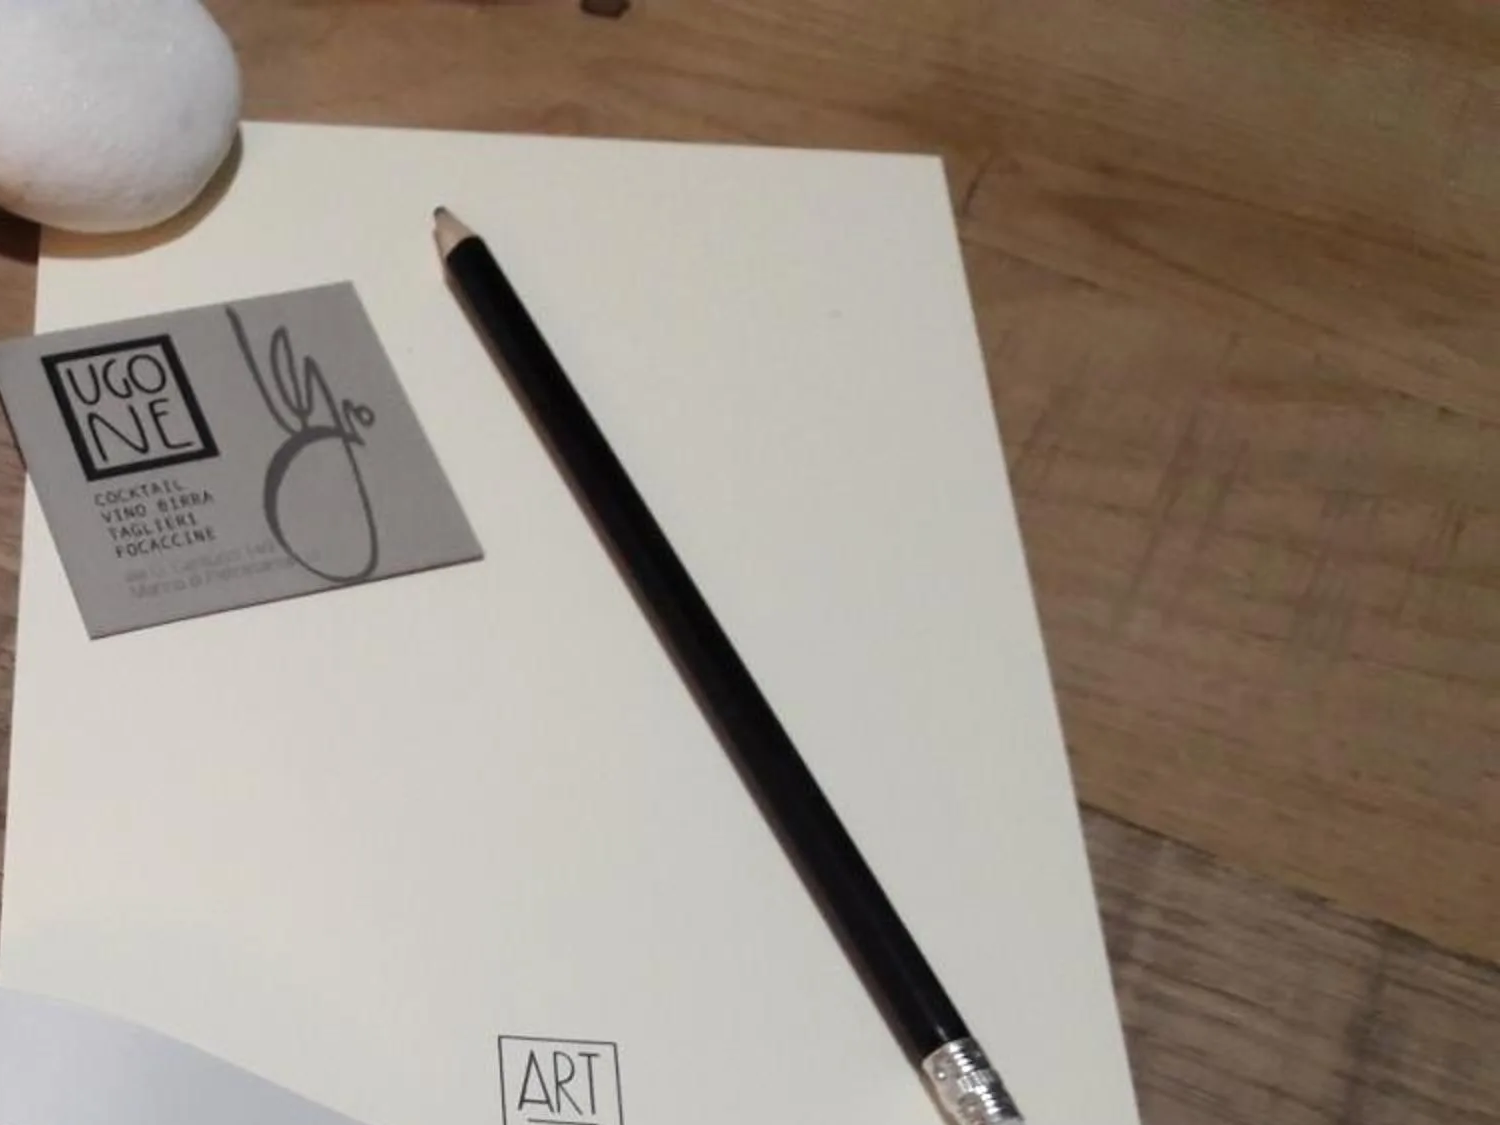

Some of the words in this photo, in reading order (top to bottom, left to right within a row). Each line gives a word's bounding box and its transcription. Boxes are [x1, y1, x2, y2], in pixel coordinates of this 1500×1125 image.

[64, 352, 168, 408] UGO
[87, 397, 196, 461] NE
[94, 479, 187, 508] COCKTAIL
[101, 503, 148, 525] VINO
[156, 488, 216, 513] BIRRA
[108, 510, 199, 542] TAGLIERI
[115, 524, 218, 559] FOCACCINE
[517, 1049, 601, 1117] ART
